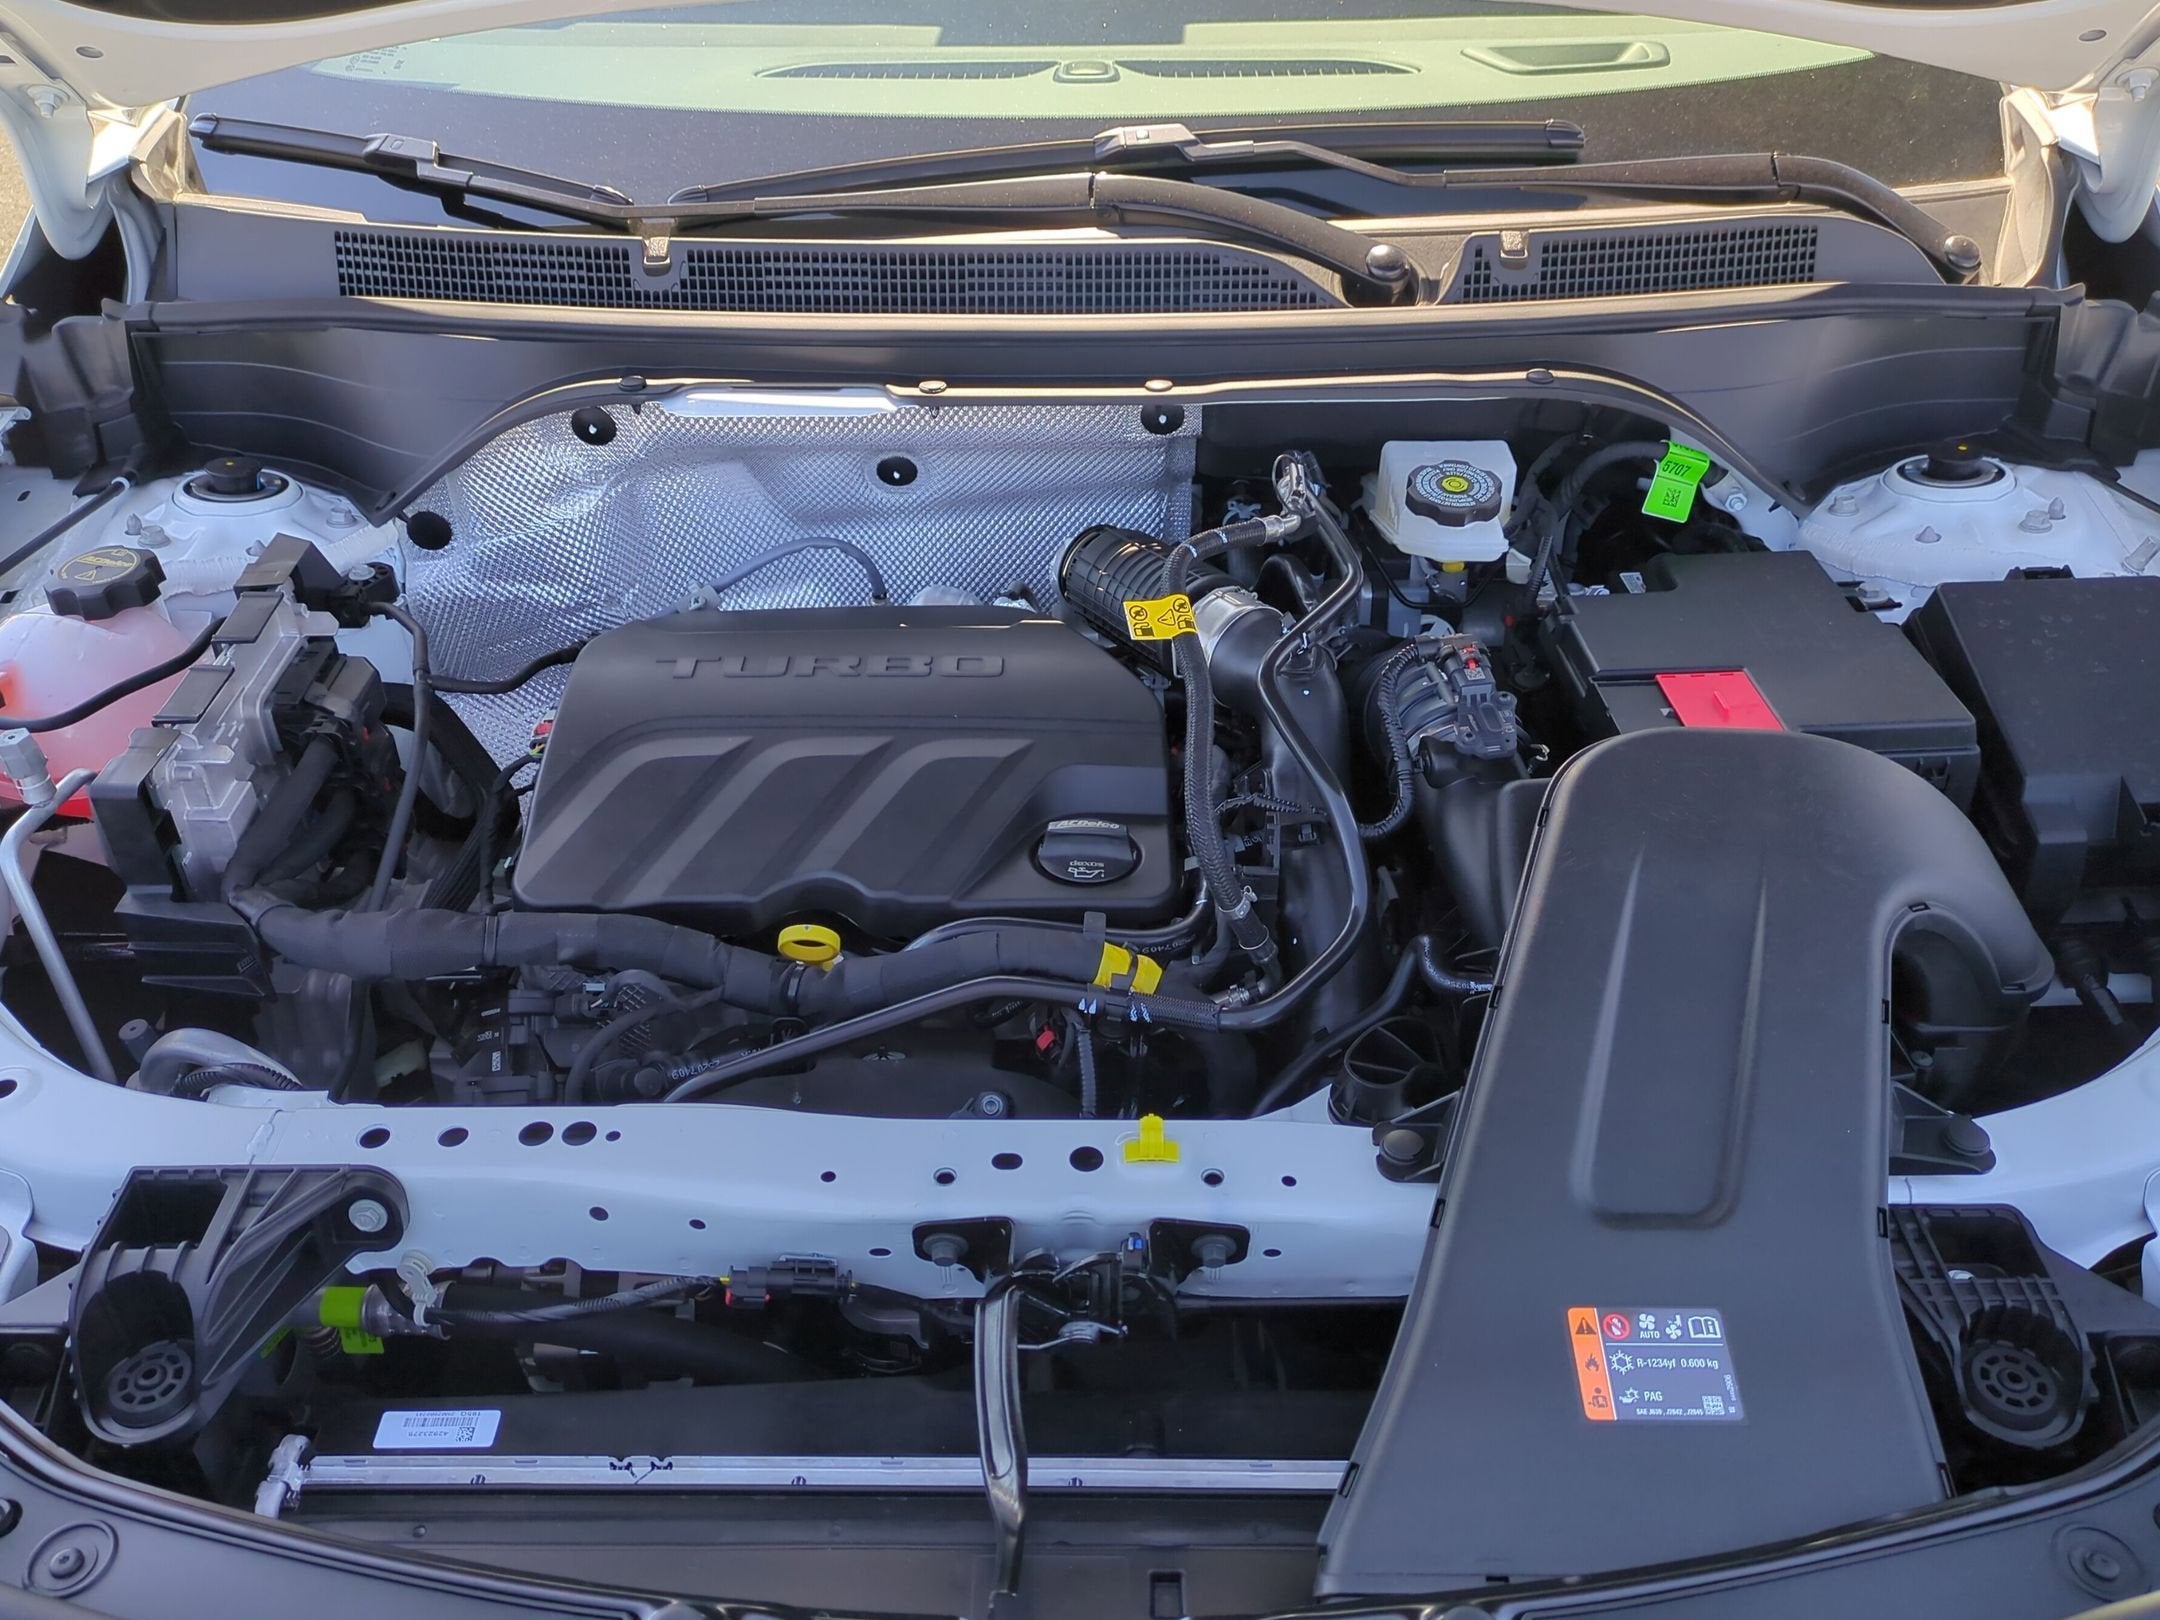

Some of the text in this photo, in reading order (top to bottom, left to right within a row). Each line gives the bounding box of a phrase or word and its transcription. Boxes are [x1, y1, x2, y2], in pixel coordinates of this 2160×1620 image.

[1662, 460, 1691, 477] 5707
[655, 656, 1005, 679] TURBO
[1640, 1331, 1660, 1339] AUTO
[1636, 1358, 1719, 1370] R-1234yf 0.600 kg
[1643, 1391, 1663, 1402] PAG
